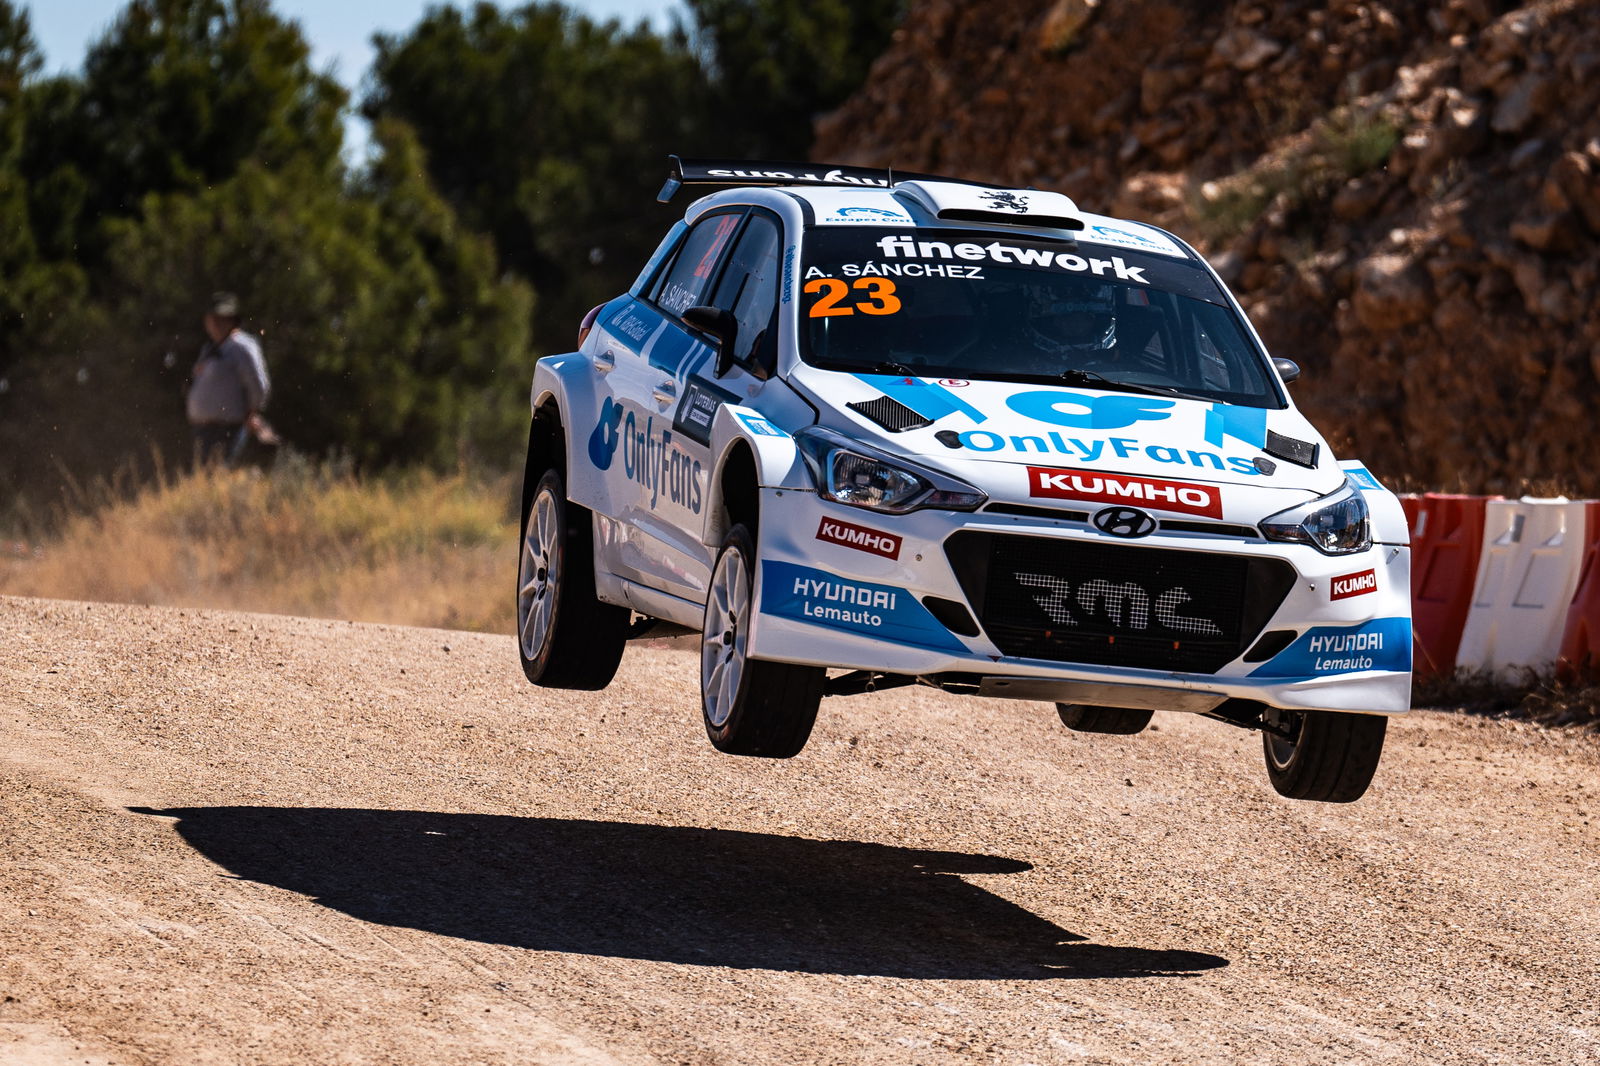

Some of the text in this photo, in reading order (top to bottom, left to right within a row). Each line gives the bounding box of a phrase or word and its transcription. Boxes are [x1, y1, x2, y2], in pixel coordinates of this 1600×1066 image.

[804, 260, 985, 280] A. SÁNCHEZ
[877, 236, 1150, 284] finetwork
[804, 277, 902, 318] 23
[624, 410, 701, 514] OnlyFans
[958, 430, 1261, 476] OnlyFans
[1040, 472, 1209, 507] KUMHO
[821, 522, 896, 553] KUMHO
[793, 577, 896, 610] HYUNDAI
[1333, 573, 1375, 595] KUMHO
[803, 601, 882, 627] Lemauto
[1309, 632, 1383, 652] HYUNDAI
[1315, 655, 1373, 671] Lemauto
